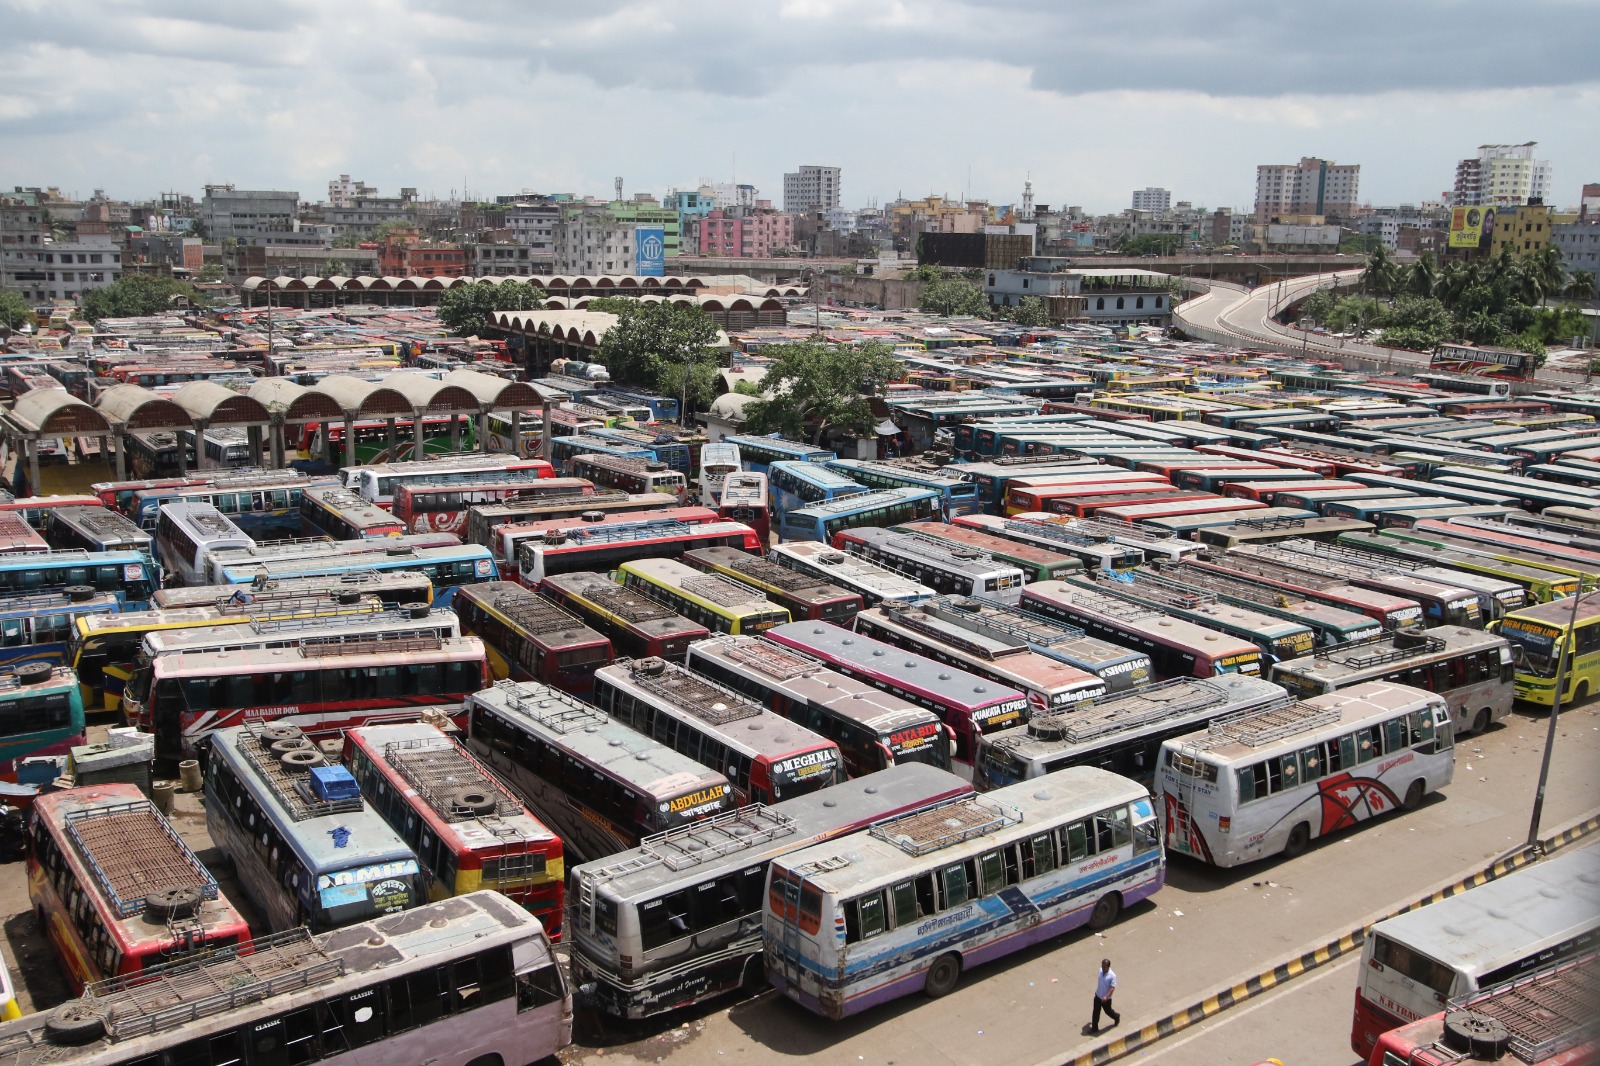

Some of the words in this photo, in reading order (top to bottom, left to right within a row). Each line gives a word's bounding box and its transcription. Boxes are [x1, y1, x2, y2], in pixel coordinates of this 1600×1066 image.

[1350, 627, 1380, 641] Meghna
[1521, 624, 1542, 634] GREEN
[1542, 628, 1560, 638] LINE
[1106, 658, 1145, 677] SHOHAG
[1061, 688, 1102, 704] Meghna
[245, 709, 259, 717] MAA
[259, 707, 282, 716] BABAR
[283, 706, 300, 715] DOYA
[972, 705, 1001, 721] KUAKATA
[1001, 699, 1028, 714] EXPRESS
[890, 724, 937, 745] SATABDI
[782, 750, 833, 771] MEGHNA
[670, 785, 724, 812] ABDULLAH
[1198, 786, 1212, 796] STAY
[334, 861, 406, 886] AMIT
[350, 989, 374, 1001] CLASSIC
[1380, 995, 1394, 1010] N.R
[1395, 1004, 1421, 1022] TRAV
[255, 1018, 282, 1031] CLASSIC
